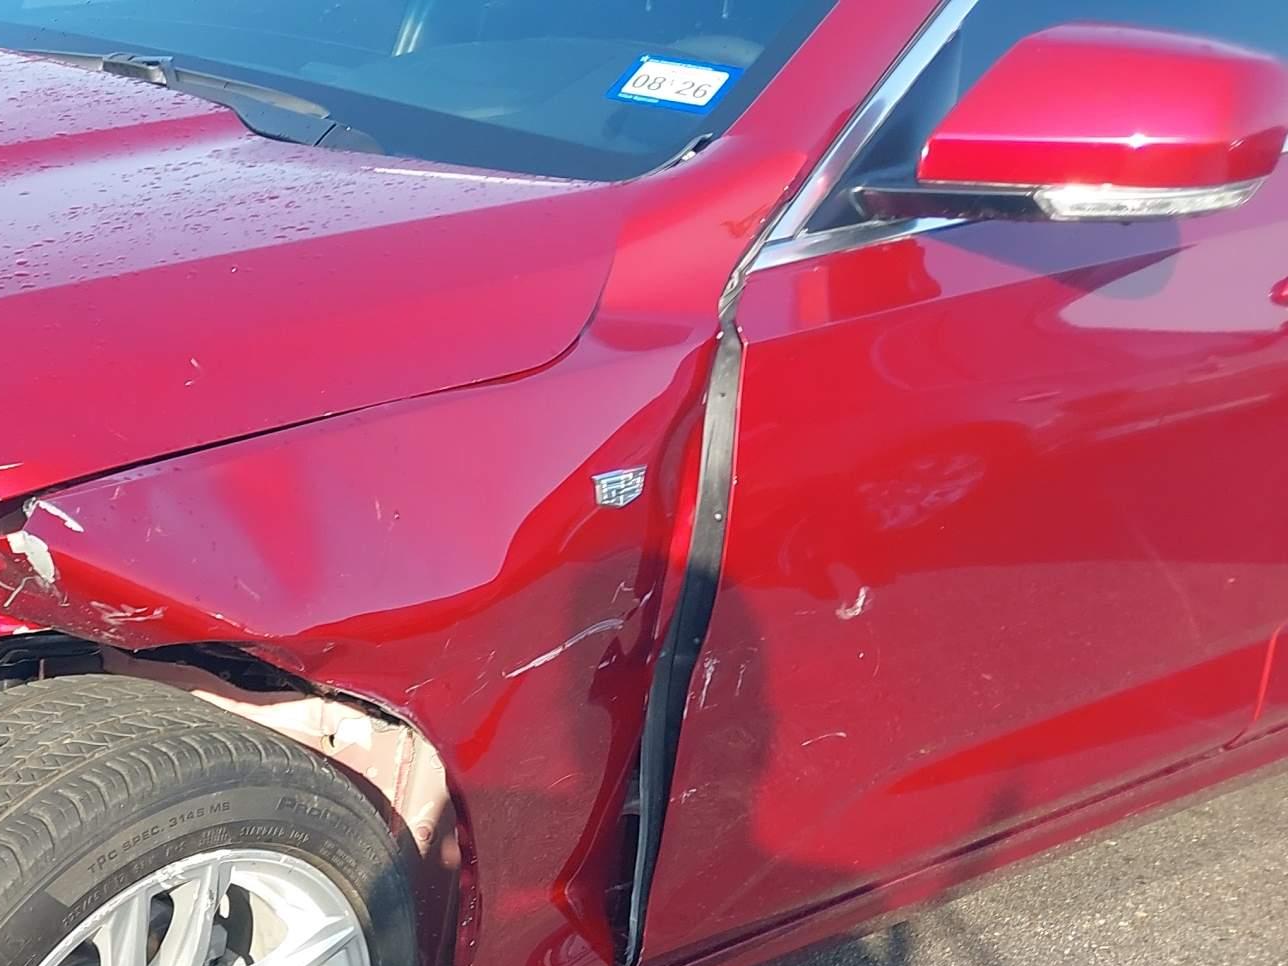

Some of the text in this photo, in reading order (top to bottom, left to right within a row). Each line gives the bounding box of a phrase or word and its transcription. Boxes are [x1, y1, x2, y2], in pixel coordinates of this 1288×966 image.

[631, 73, 667, 92] 08
[675, 80, 712, 99] 26
[87, 848, 119, 874] TPC
[122, 824, 165, 852] SPEC.
